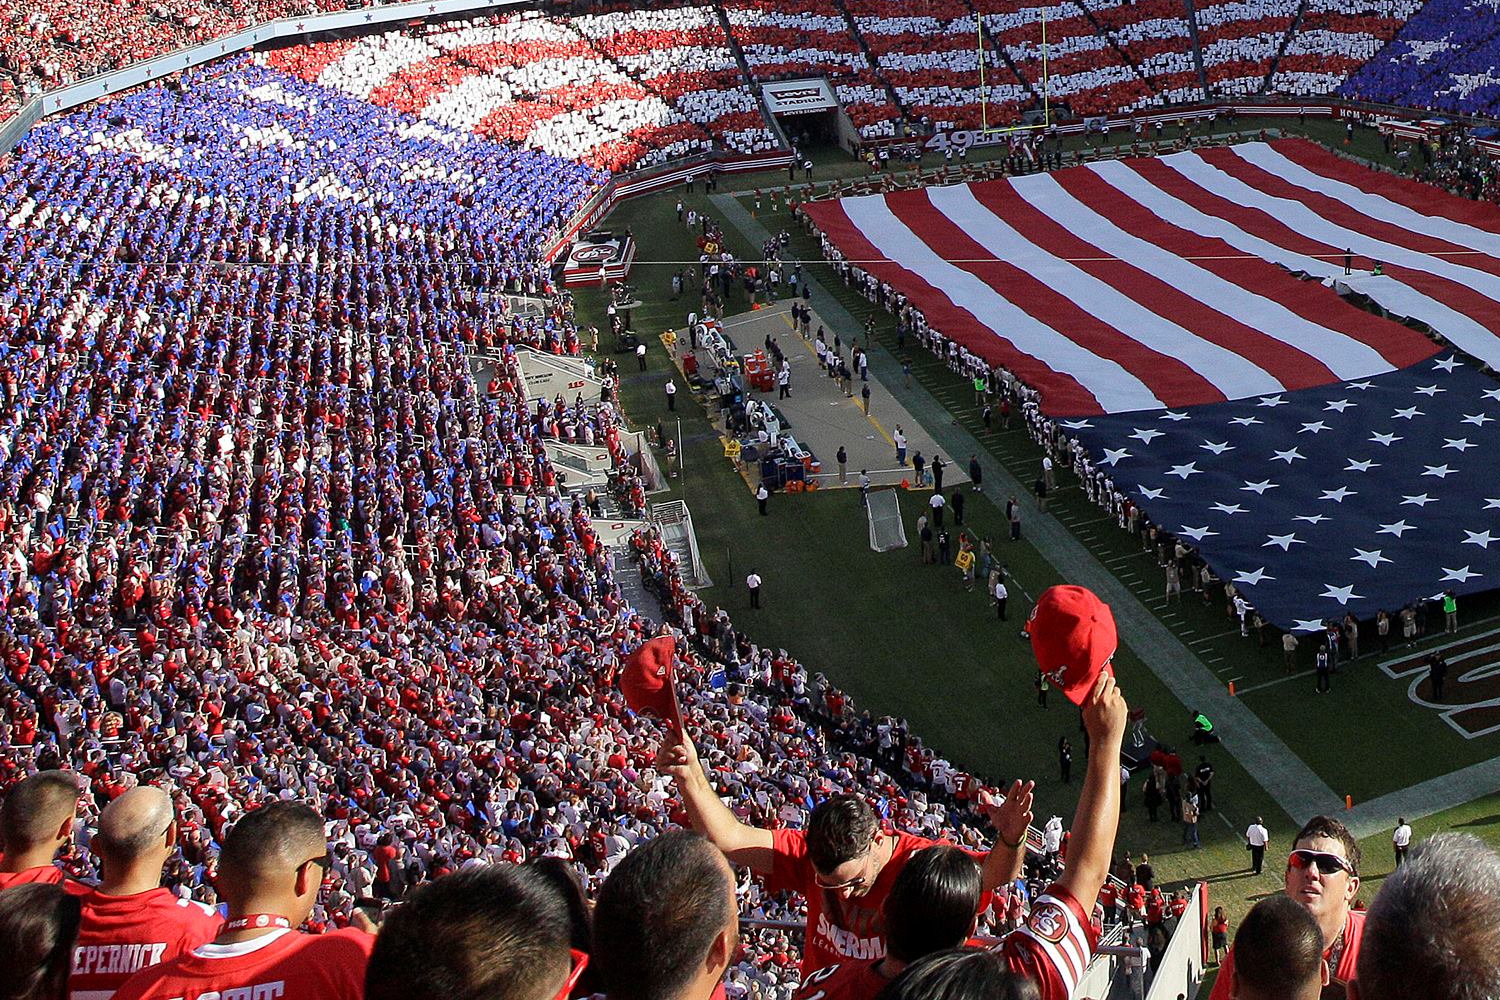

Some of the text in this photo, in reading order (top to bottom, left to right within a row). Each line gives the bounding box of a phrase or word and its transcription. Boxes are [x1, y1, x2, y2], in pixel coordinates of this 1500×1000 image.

[775, 97, 826, 106] STADIUM
[568, 380, 585, 389] 115
[72, 943, 167, 976] EPERNICK
